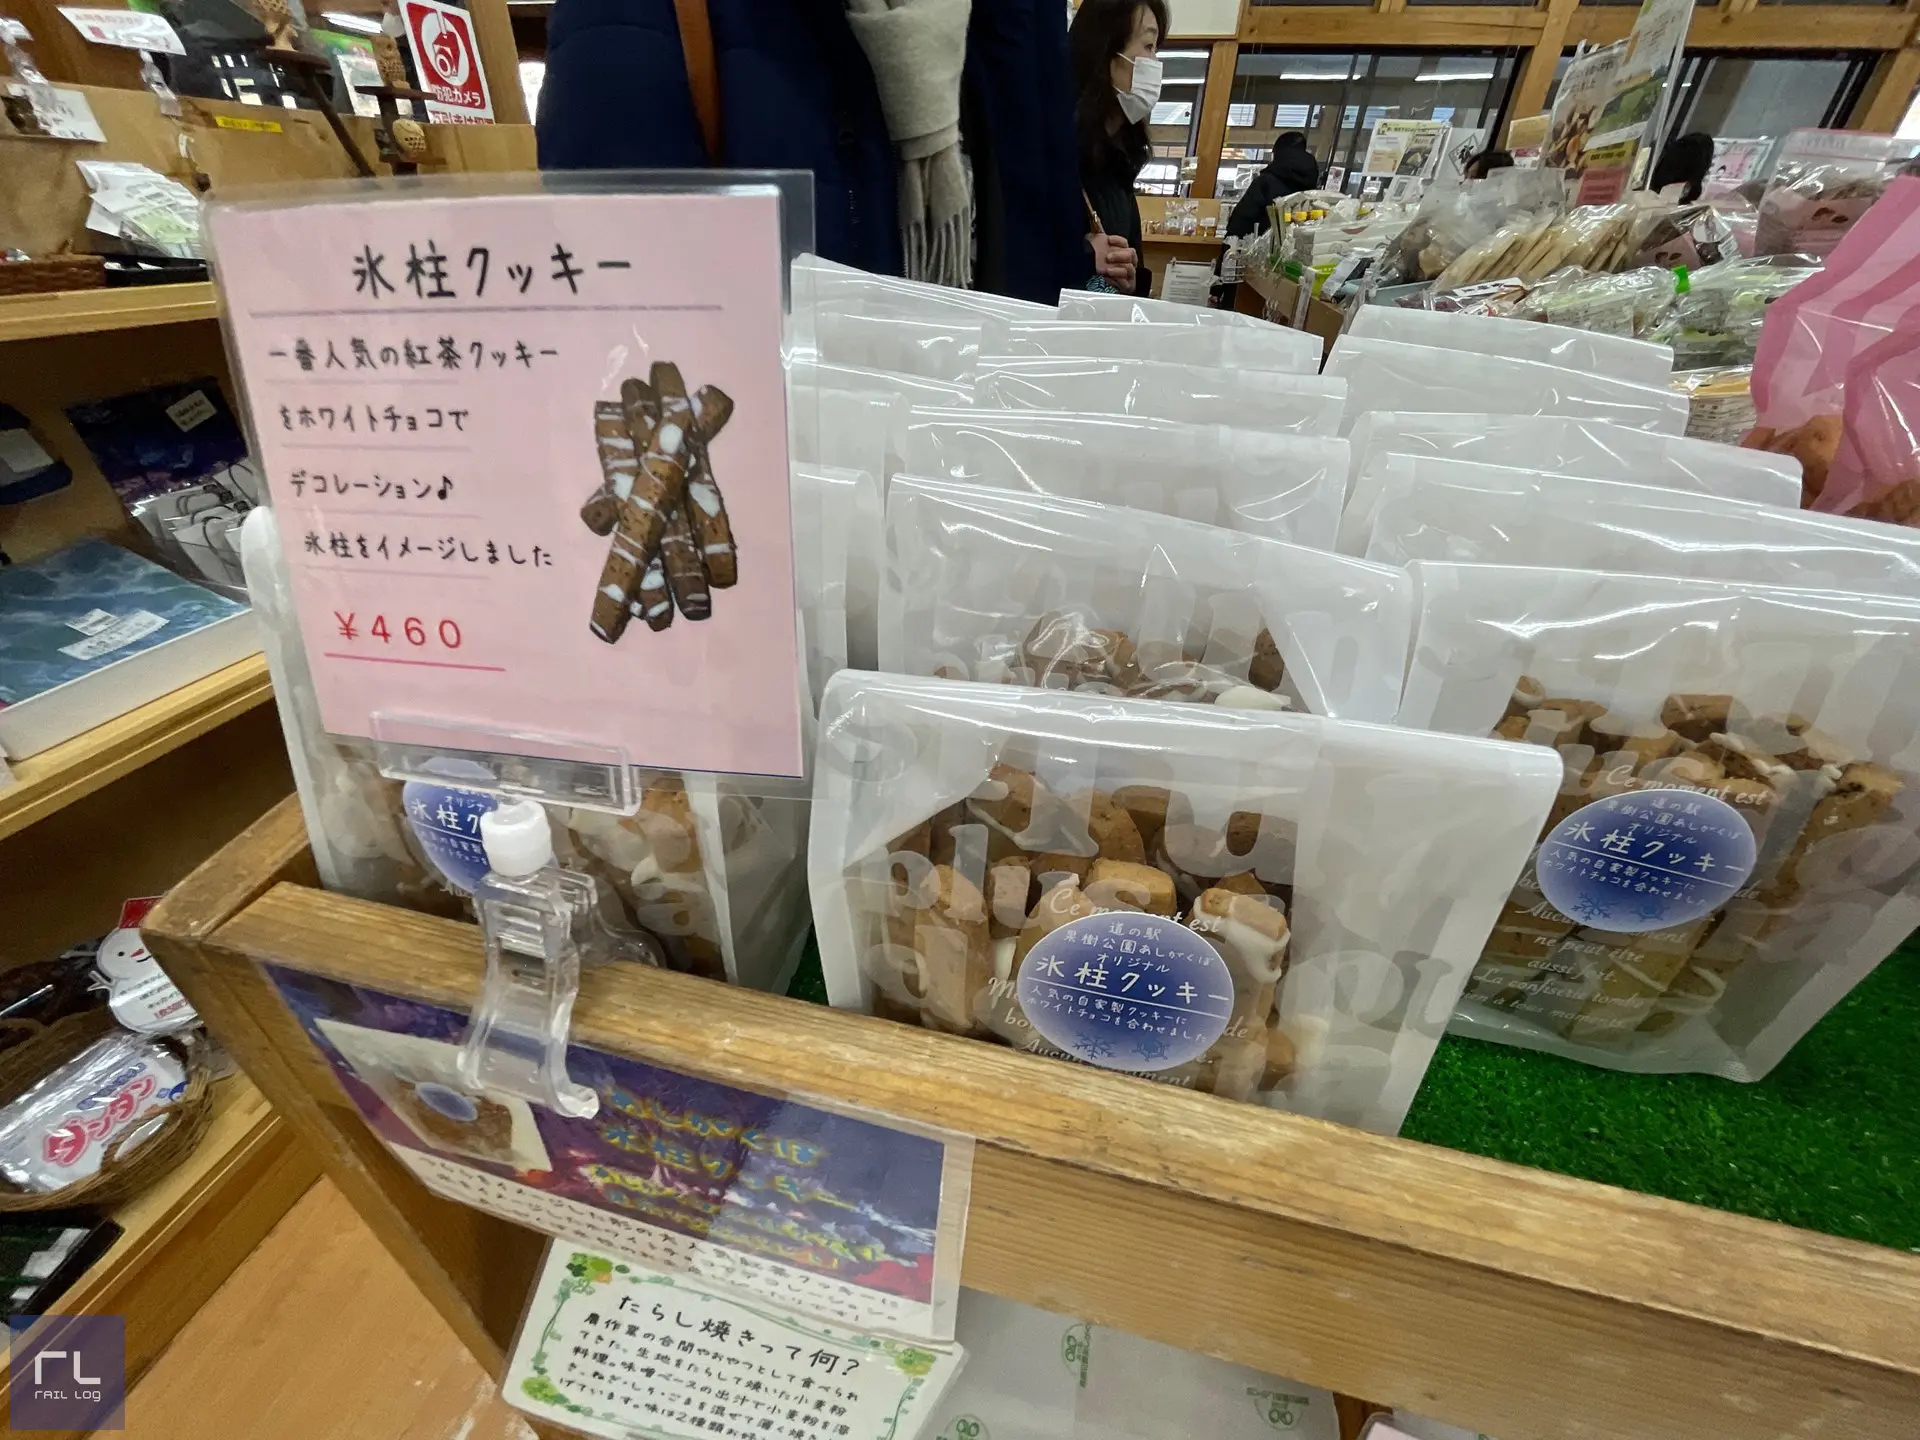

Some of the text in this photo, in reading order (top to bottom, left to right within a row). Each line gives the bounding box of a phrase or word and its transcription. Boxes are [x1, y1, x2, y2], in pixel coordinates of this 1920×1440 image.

[431, 84, 481, 106] 防犯カメラ
[351, 240, 631, 300] 氷柱クッキー
[268, 334, 559, 372] 一番人気の紅茶クッキー
[279, 403, 470, 433] をホワイトチョコで
[303, 529, 553, 569] 氷柱をイメージしました
[335, 609, 463, 651] ¥460
[1564, 820, 1745, 873] 氷柱クッキー
[1627, 822, 1699, 845] オリジナル
[1063, 929, 1216, 968] 果樹公園あしがくぼ
[1108, 921, 1162, 942] 道の駅
[1035, 954, 1231, 1005] 氷柱クッキー
[1096, 953, 1171, 974] オリジナル
[1025, 997, 1207, 1043] ホワイトチョコを合わせました
[1030, 985, 1188, 1026] 人気の自家製クッキーに
[618, 1295, 861, 1377] たらし焼きって何？
